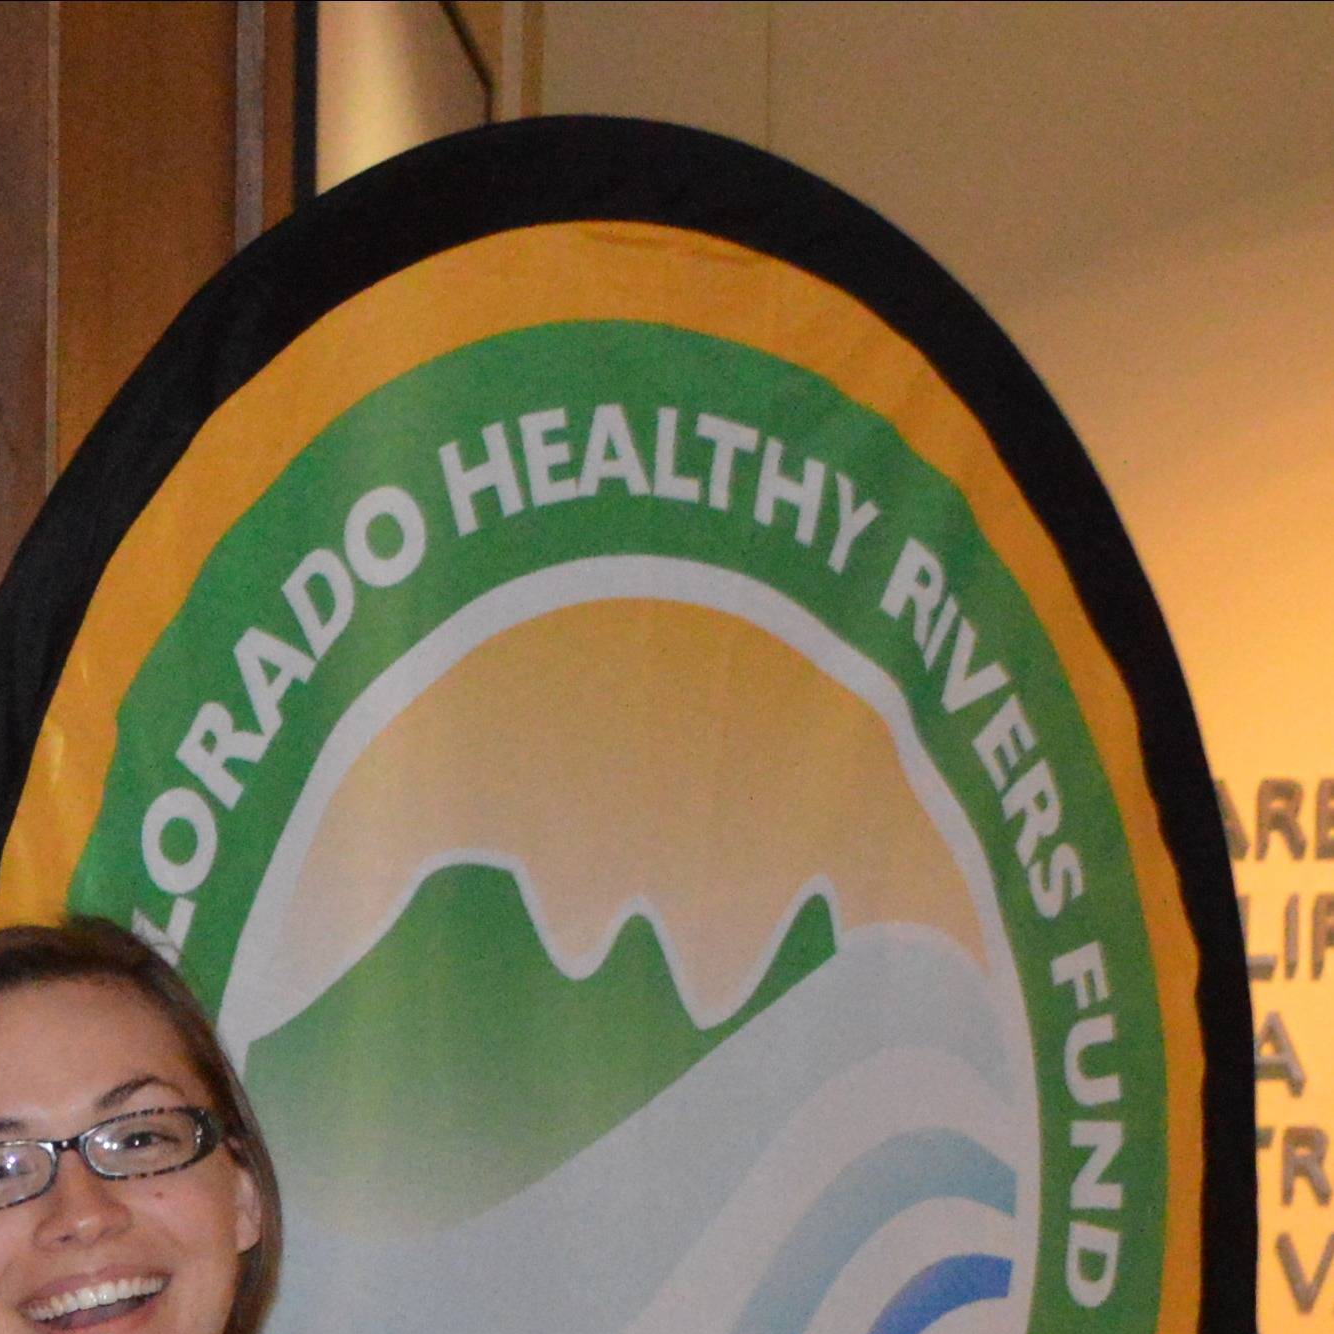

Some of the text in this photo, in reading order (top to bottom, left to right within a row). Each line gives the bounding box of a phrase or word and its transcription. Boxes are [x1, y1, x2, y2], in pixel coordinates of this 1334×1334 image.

[131, 403, 1123, 1309] LORADO HEALTHY RIVERS FUND
